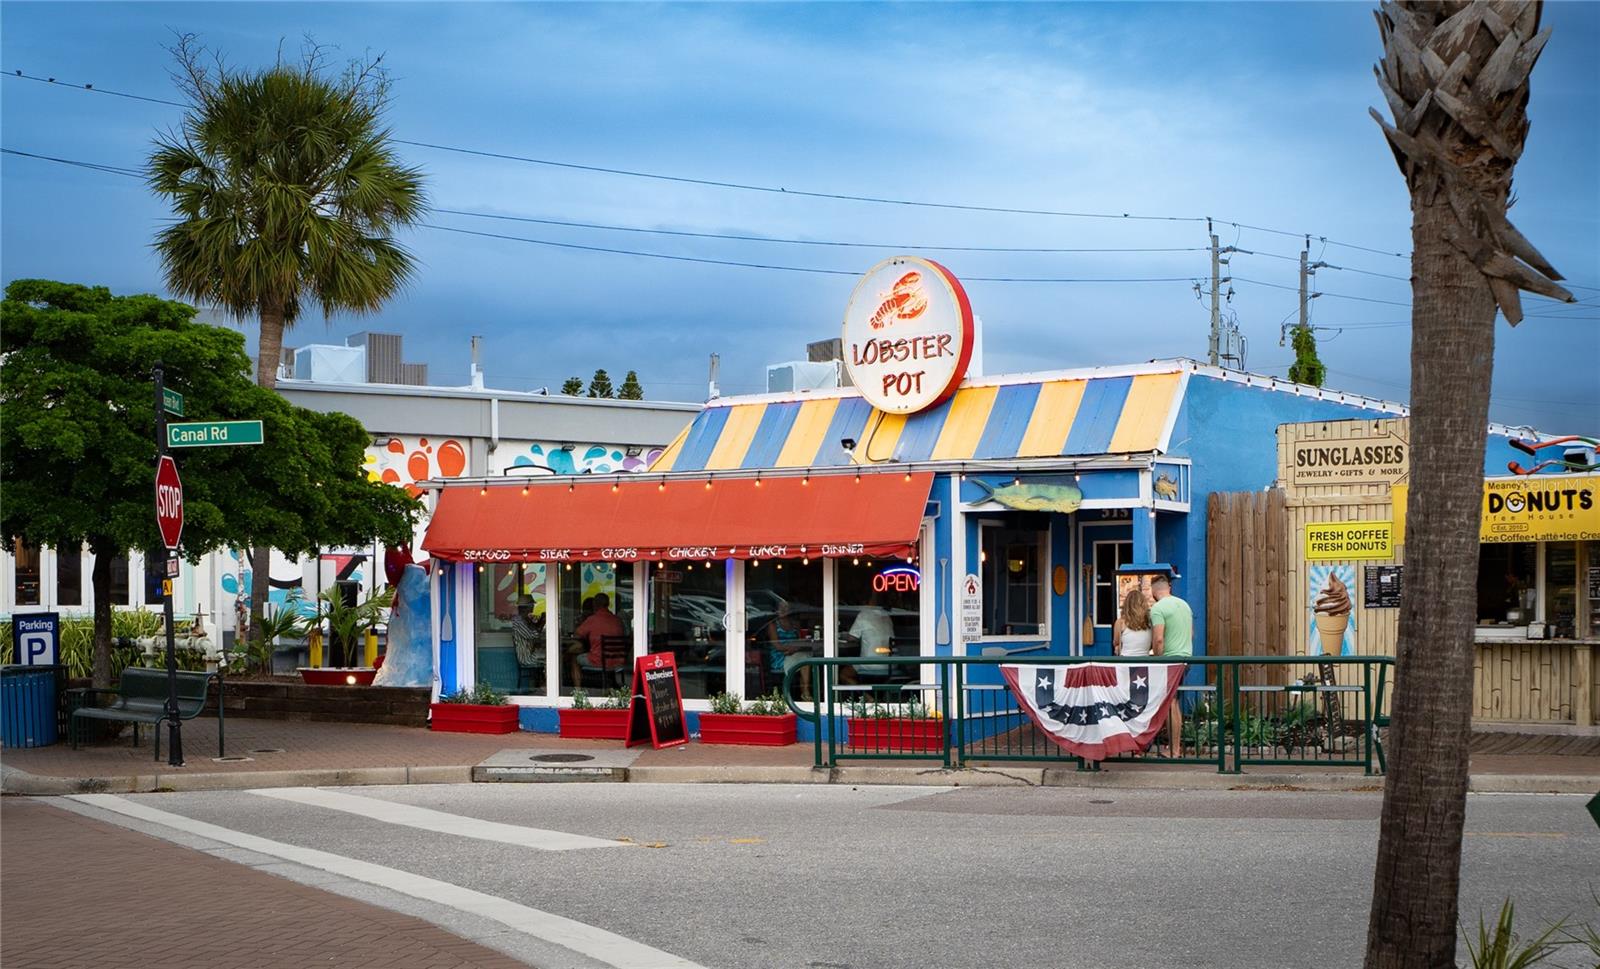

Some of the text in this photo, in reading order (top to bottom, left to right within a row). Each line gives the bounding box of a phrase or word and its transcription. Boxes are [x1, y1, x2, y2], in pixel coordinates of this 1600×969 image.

[852, 334, 954, 366] LOBSTER
[882, 370, 925, 397] POT
[171, 426, 228, 442] Canal Rd
[1296, 445, 1404, 468] SUNGLASSES
[1296, 470, 1333, 478] JEWELRY
[1340, 469, 1363, 477] GIFTS
[1380, 467, 1404, 475] MORE
[159, 484, 180, 519] STOP
[1488, 489, 1593, 513] DONUTS
[1309, 529, 1389, 541] FRESH COFFEE
[1485, 531, 1600, 542] Ice Coffee Latte Ice Crea
[464, 543, 864, 560] SEAFOOD STEAK CHOPS CHICKEN LUNCH DINNER
[1311, 541, 1387, 552] FRESH DONUTS
[873, 574, 918, 592] OPEN
[19, 620, 53, 631] Parking
[27, 637, 47, 666] P
